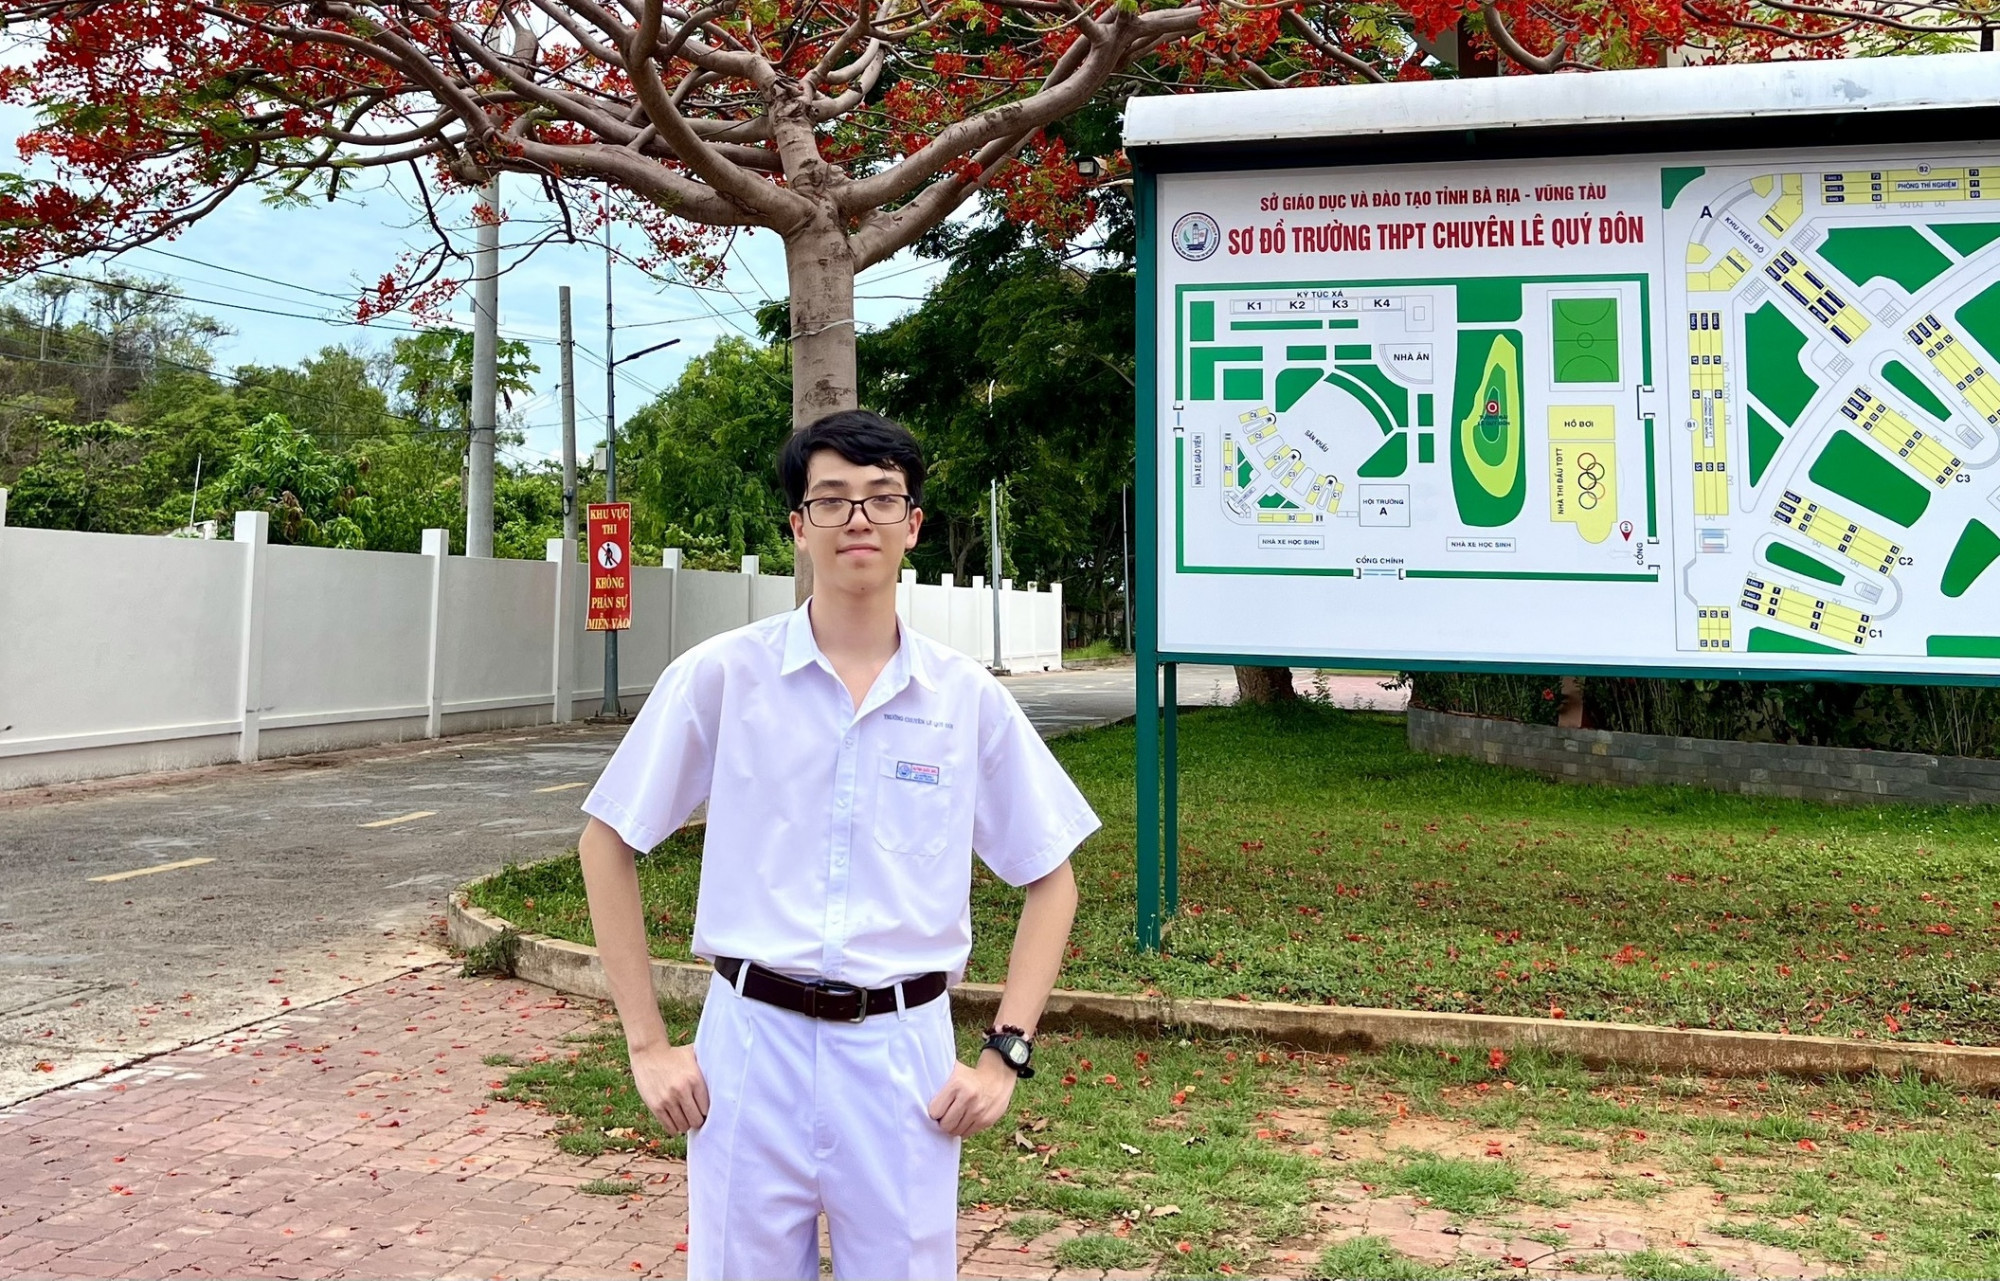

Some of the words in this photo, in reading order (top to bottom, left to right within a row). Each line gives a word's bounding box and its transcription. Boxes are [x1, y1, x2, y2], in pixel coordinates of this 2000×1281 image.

[1932, 180, 1956, 188] NGHIỆM
[1261, 192, 1278, 211] SỞ
[1283, 193, 1314, 210] GIÁO
[1319, 194, 1346, 212] DỤC
[1350, 190, 1369, 208] VÀ
[1372, 189, 1401, 207] ĐÀO
[1405, 191, 1431, 208] TẠO
[1436, 186, 1468, 205] TỈNH
[1473, 186, 1492, 204] BÀ
[1496, 187, 1521, 206] RỊA
[1535, 184, 1574, 201] VŨNG
[1578, 182, 1607, 200] TÀU
[1700, 206, 1713, 218] A
[1228, 226, 1254, 255] SƠ
[1259, 219, 1285, 254] ĐỒ
[1292, 219, 1371, 253] TRƯỜNG
[1377, 223, 1427, 250] THPT
[1433, 215, 1514, 249] CHUYÊN
[1521, 213, 1544, 246] LÊ
[1552, 212, 1592, 248] QUÝ
[1599, 211, 1644, 244] ĐÔN
[1725, 217, 1740, 231] KHU
[1738, 229, 1754, 244] HIỆU
[1753, 243, 1764, 253] BỘ
[1311, 290, 1329, 298] TÚC
[1331, 289, 1343, 298] XÁ
[1247, 302, 1262, 310] K1
[1289, 300, 1306, 309] K2
[1332, 300, 1349, 309] K3
[1373, 298, 1391, 308] K4
[1393, 351, 1414, 361] NHÀ
[1416, 351, 1430, 361] ĂN
[1564, 418, 1577, 428] HỒ
[1555, 447, 1563, 466] TDTT
[1554, 467, 1564, 483] ĐẤU
[1956, 474, 1971, 483] C3
[1556, 484, 1564, 497] THI
[1379, 507, 1388, 516] A
[1555, 498, 1564, 515] NHÀ
[590, 509, 609, 520] KHU
[610, 506, 629, 521] VỰC
[602, 524, 618, 535] THI
[1355, 555, 1378, 564] CỔNG
[1379, 556, 1404, 564] CHÍNH
[1633, 542, 1644, 566] CỔNG
[1898, 557, 1914, 566] C2
[595, 574, 624, 589] KHÔNG
[615, 594, 628, 611] SỰ
[587, 612, 609, 630] MIỄN
[611, 614, 630, 629] VÀO
[1869, 629, 1883, 638] C1
